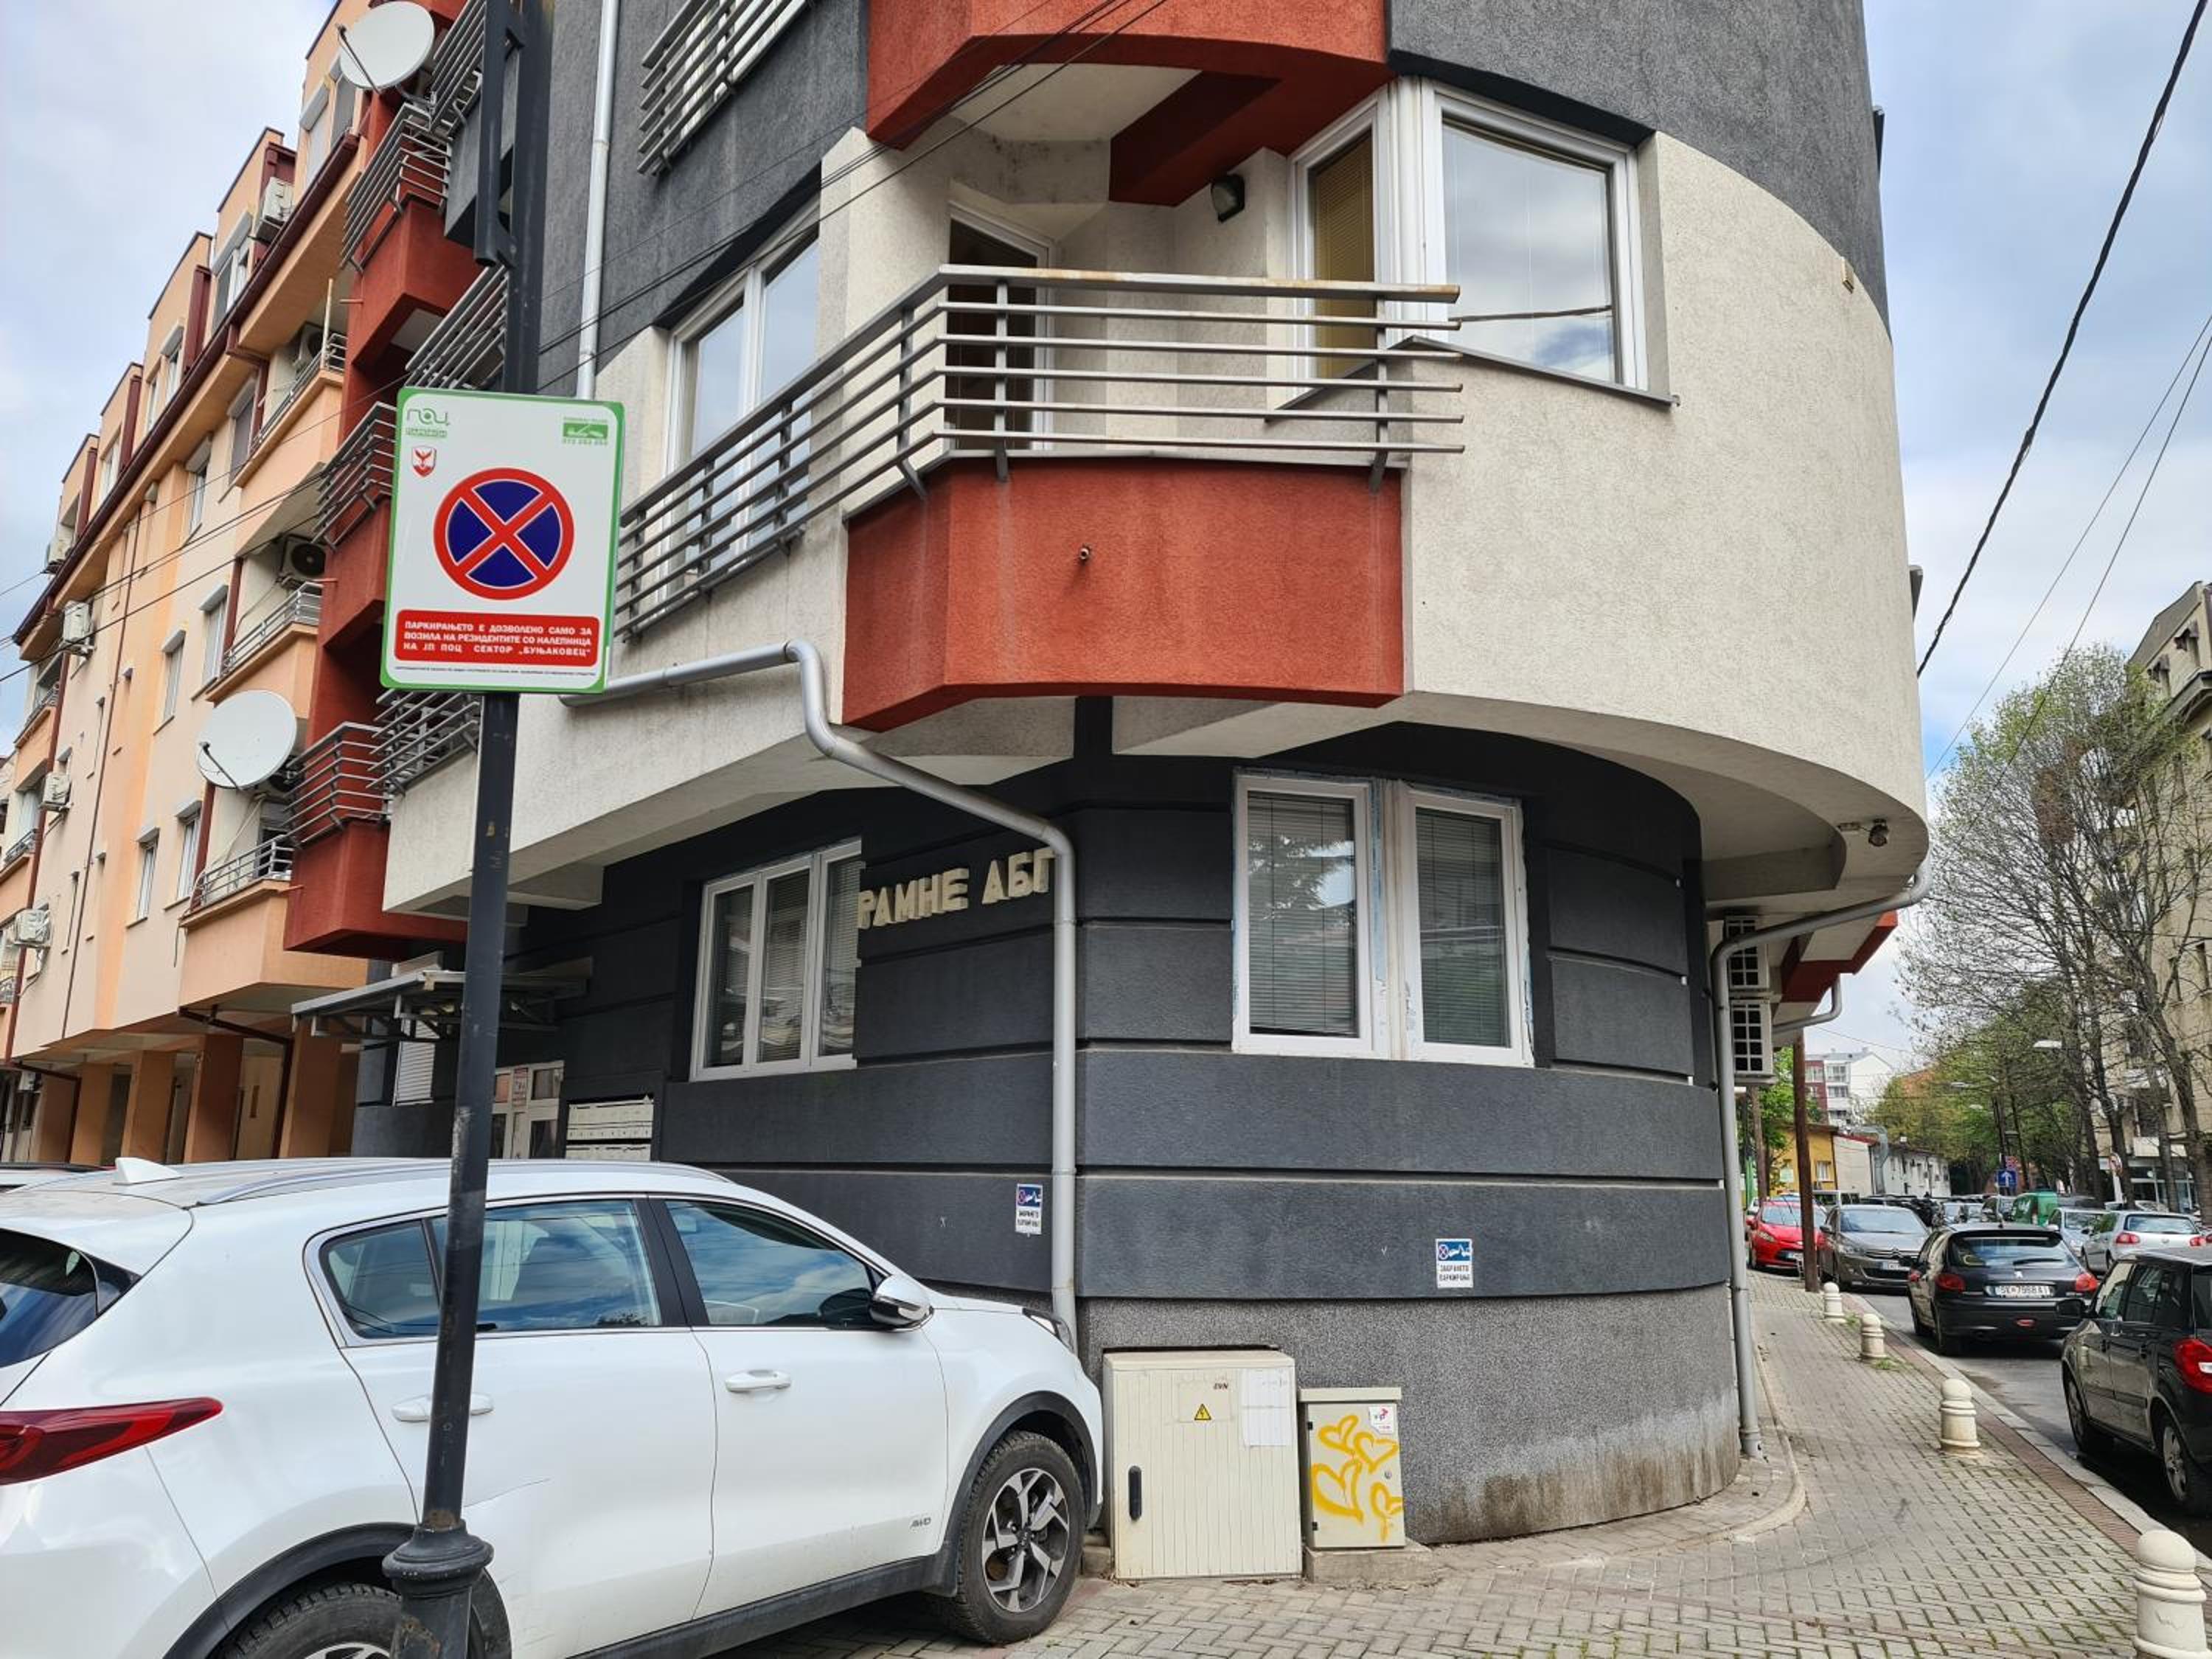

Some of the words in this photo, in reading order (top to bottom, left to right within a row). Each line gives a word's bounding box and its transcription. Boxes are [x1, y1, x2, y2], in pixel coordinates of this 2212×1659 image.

[405, 621, 473, 632] ПАРКИРАЊЕТО
[489, 625, 543, 633] ДОЗВОЛЕНО
[548, 626, 575, 635] САМО
[580, 627, 592, 636] ЗА
[404, 632, 441, 641] ВОЗИЛА
[458, 633, 520, 645] РЕЗИДЕНТИТЕ
[522, 636, 535, 644] СО
[537, 636, 591, 647] НАЛЕПНИЦА
[403, 642, 417, 650] НА
[423, 643, 435, 652] ЈП
[441, 644, 462, 653] ПОЦ
[473, 644, 512, 654] СЕКТОР
